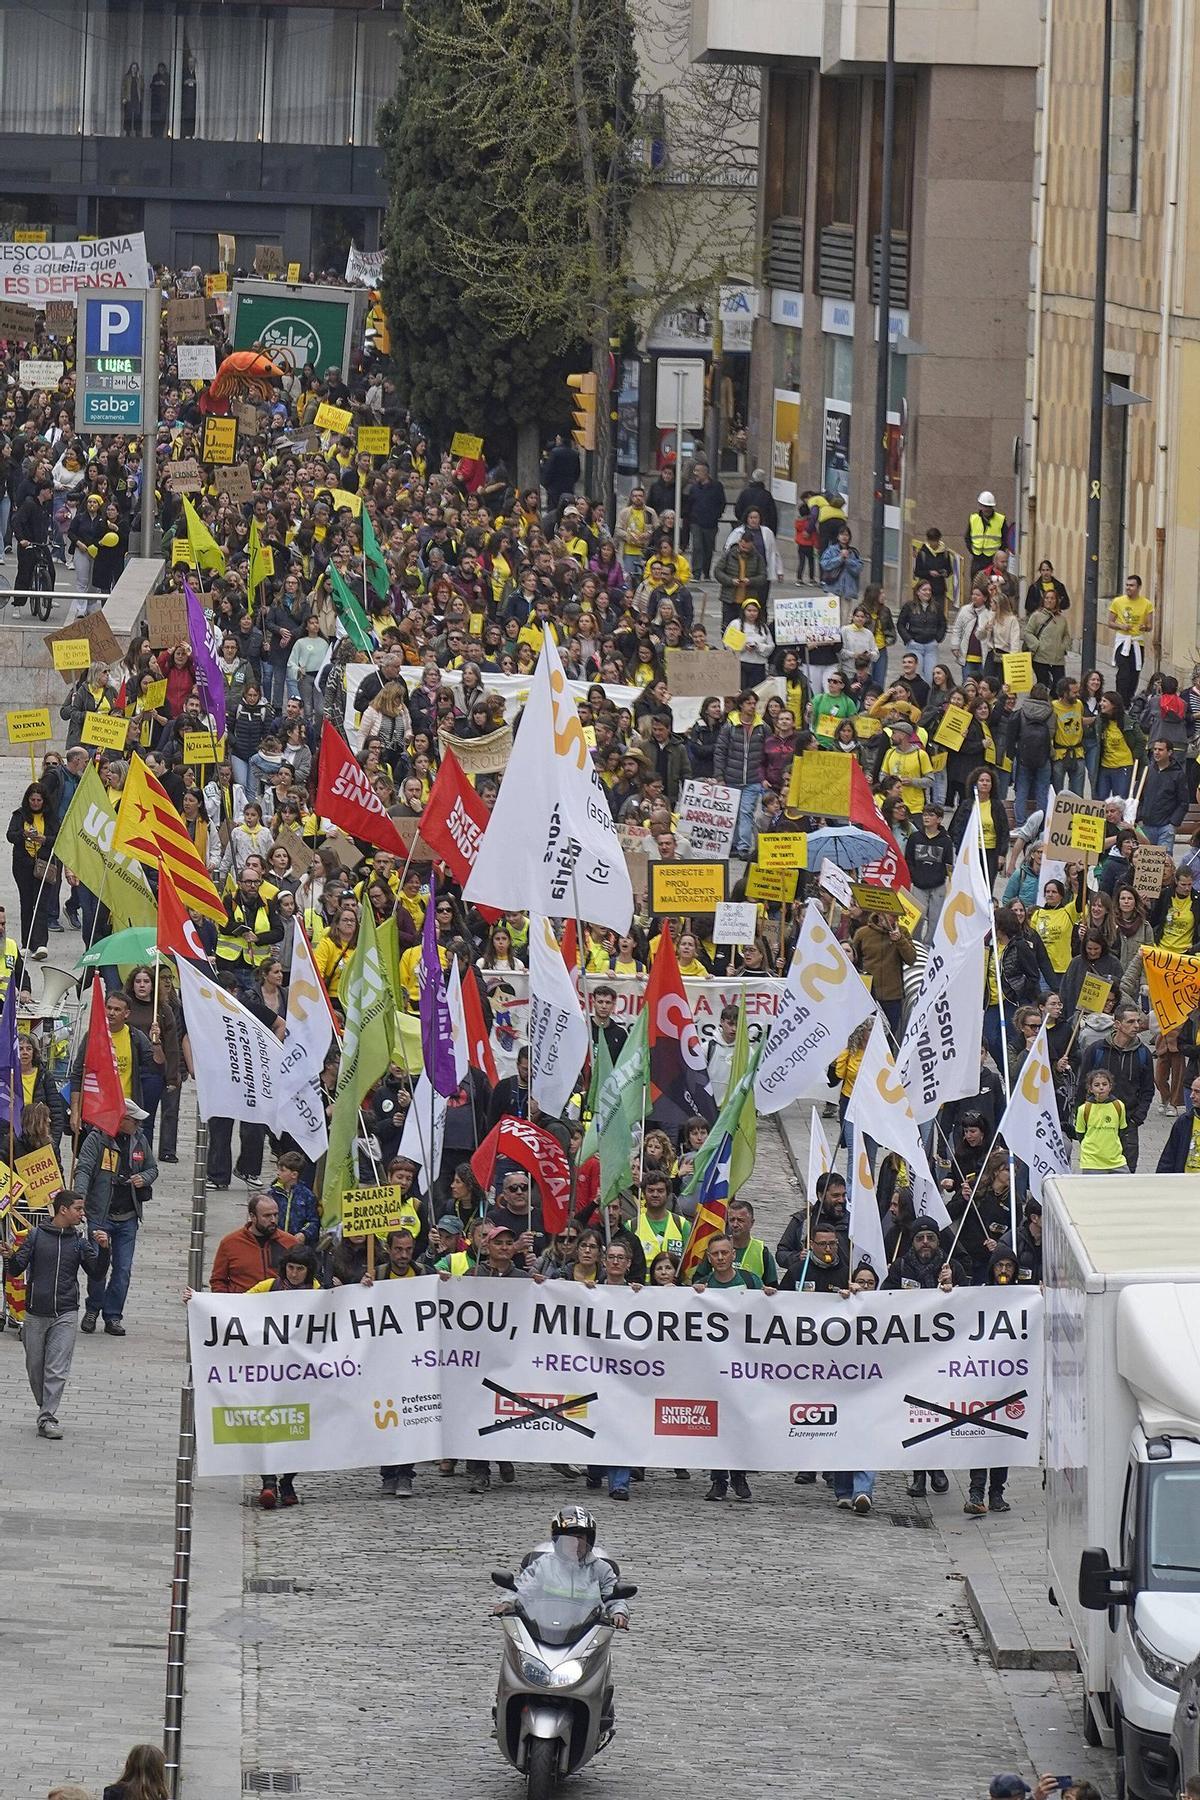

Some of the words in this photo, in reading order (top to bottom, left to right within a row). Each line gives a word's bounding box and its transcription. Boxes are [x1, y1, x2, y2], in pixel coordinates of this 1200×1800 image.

[81, 239, 132, 258] DIGNA
[13, 261, 30, 274] és
[34, 260, 86, 276] aquella
[90, 259, 116, 273] que
[35, 272, 127, 294] DEFENSA
[100, 304, 130, 351] P
[687, 783, 694, 793] A
[659, 868, 705, 876] RESPECTE
[675, 887, 716, 895] DOCENTS
[1146, 950, 1200, 975] AULES
[25, 1158, 54, 1177] TERRA
[29, 1170, 60, 1191] CLASSE
[354, 1187, 395, 1202] SALARIS
[353, 1200, 401, 1219] BUROCRÀCIA
[353, 1216, 389, 1231] CATALÀ
[204, 1315, 248, 1347] JA
[263, 1312, 338, 1346] N'HI
[351, 1304, 403, 1340] HA
[415, 1299, 519, 1341] PROU,
[533, 1302, 730, 1343] MILLORES
[744, 1311, 956, 1347] LABORALS
[968, 1309, 1029, 1342] JA!
[207, 1364, 222, 1384] A
[228, 1354, 362, 1384] L'EDUCACIÓ:
[532, 1355, 666, 1378] +RECURSOS
[720, 1358, 884, 1381] -BUROCRÀCIA
[938, 1355, 1029, 1378] -RÀTIOS
[402, 1405, 413, 1414] de
[661, 1405, 692, 1416] INTER
[793, 1406, 835, 1424] CGT
[661, 1414, 711, 1425] SINDICAL
[290, 1426, 304, 1436] IAC
[950, 1427, 986, 1437] Educació
